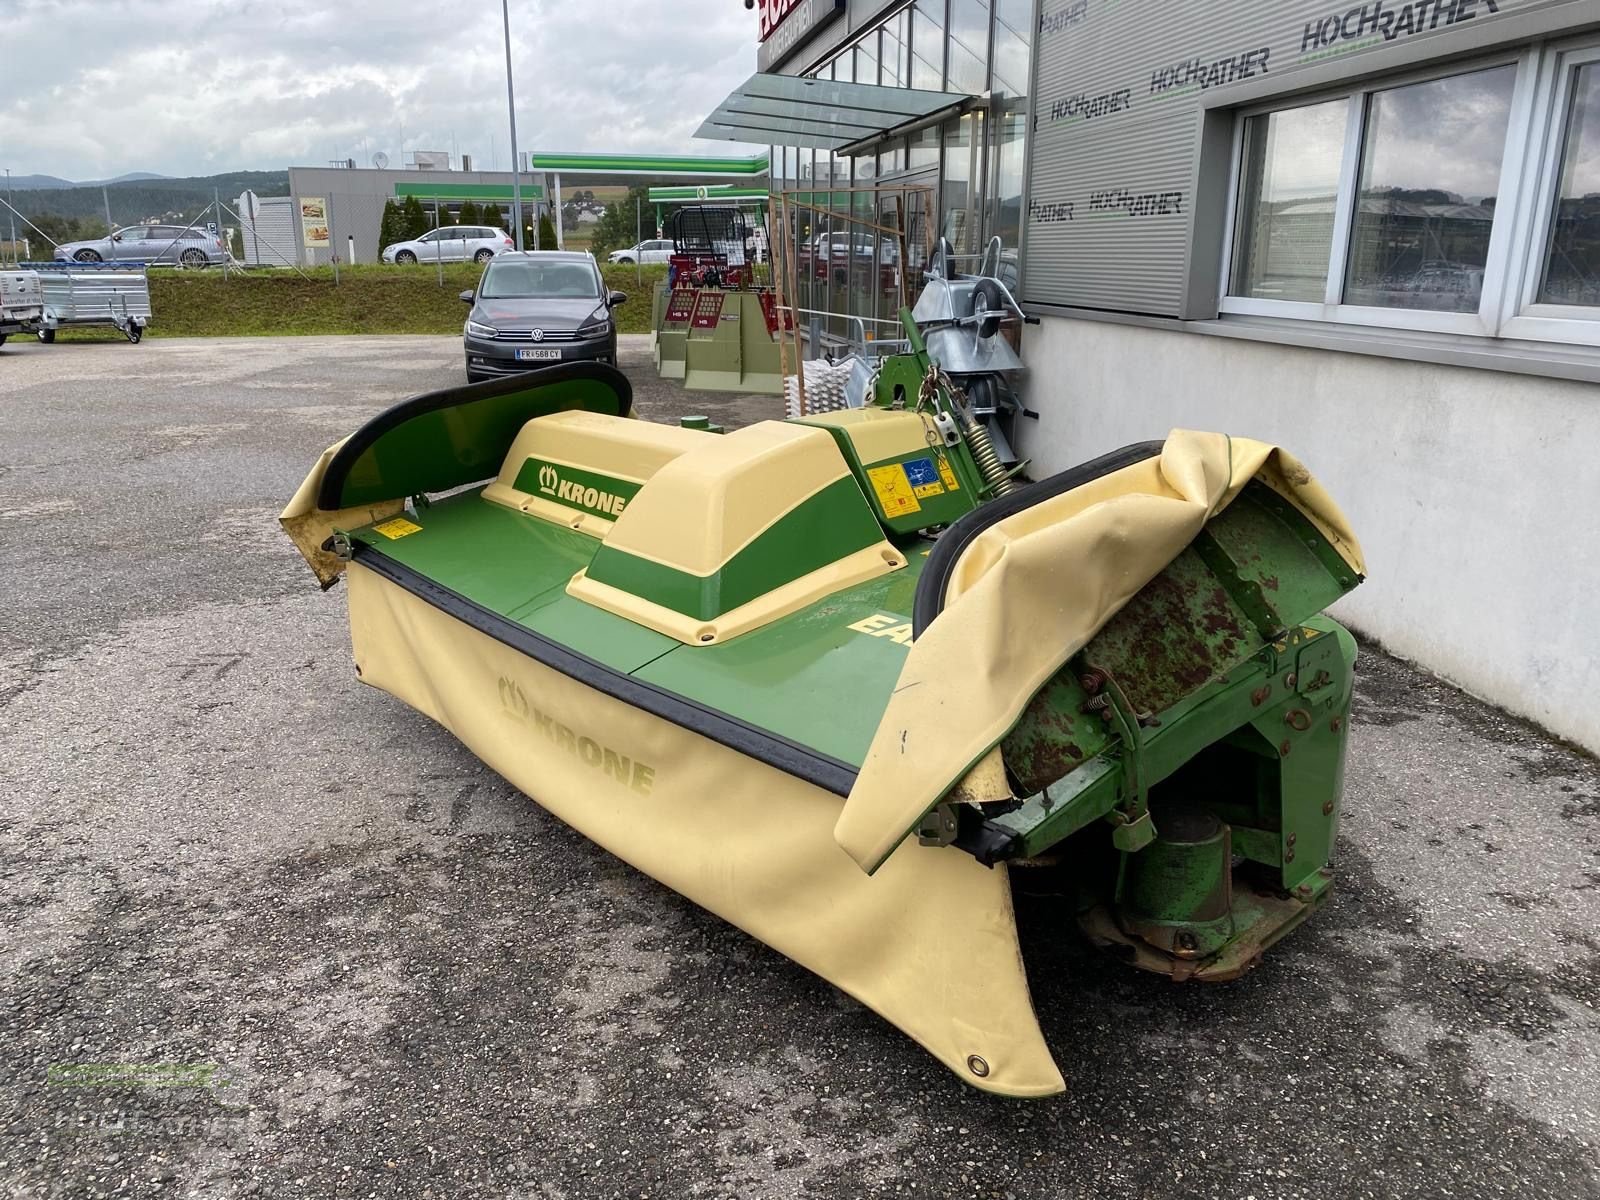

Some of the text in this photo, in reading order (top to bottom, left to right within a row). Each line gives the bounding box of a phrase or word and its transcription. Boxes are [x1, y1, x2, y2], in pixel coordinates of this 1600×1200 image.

[1150, 47, 1270, 92] HOCHRATHER
[1051, 88, 1130, 121] HOCHRATHER
[1089, 189, 1182, 217] HOCHRATHER
[557, 480, 627, 515] KRONE
[534, 708, 656, 797] KRONE
